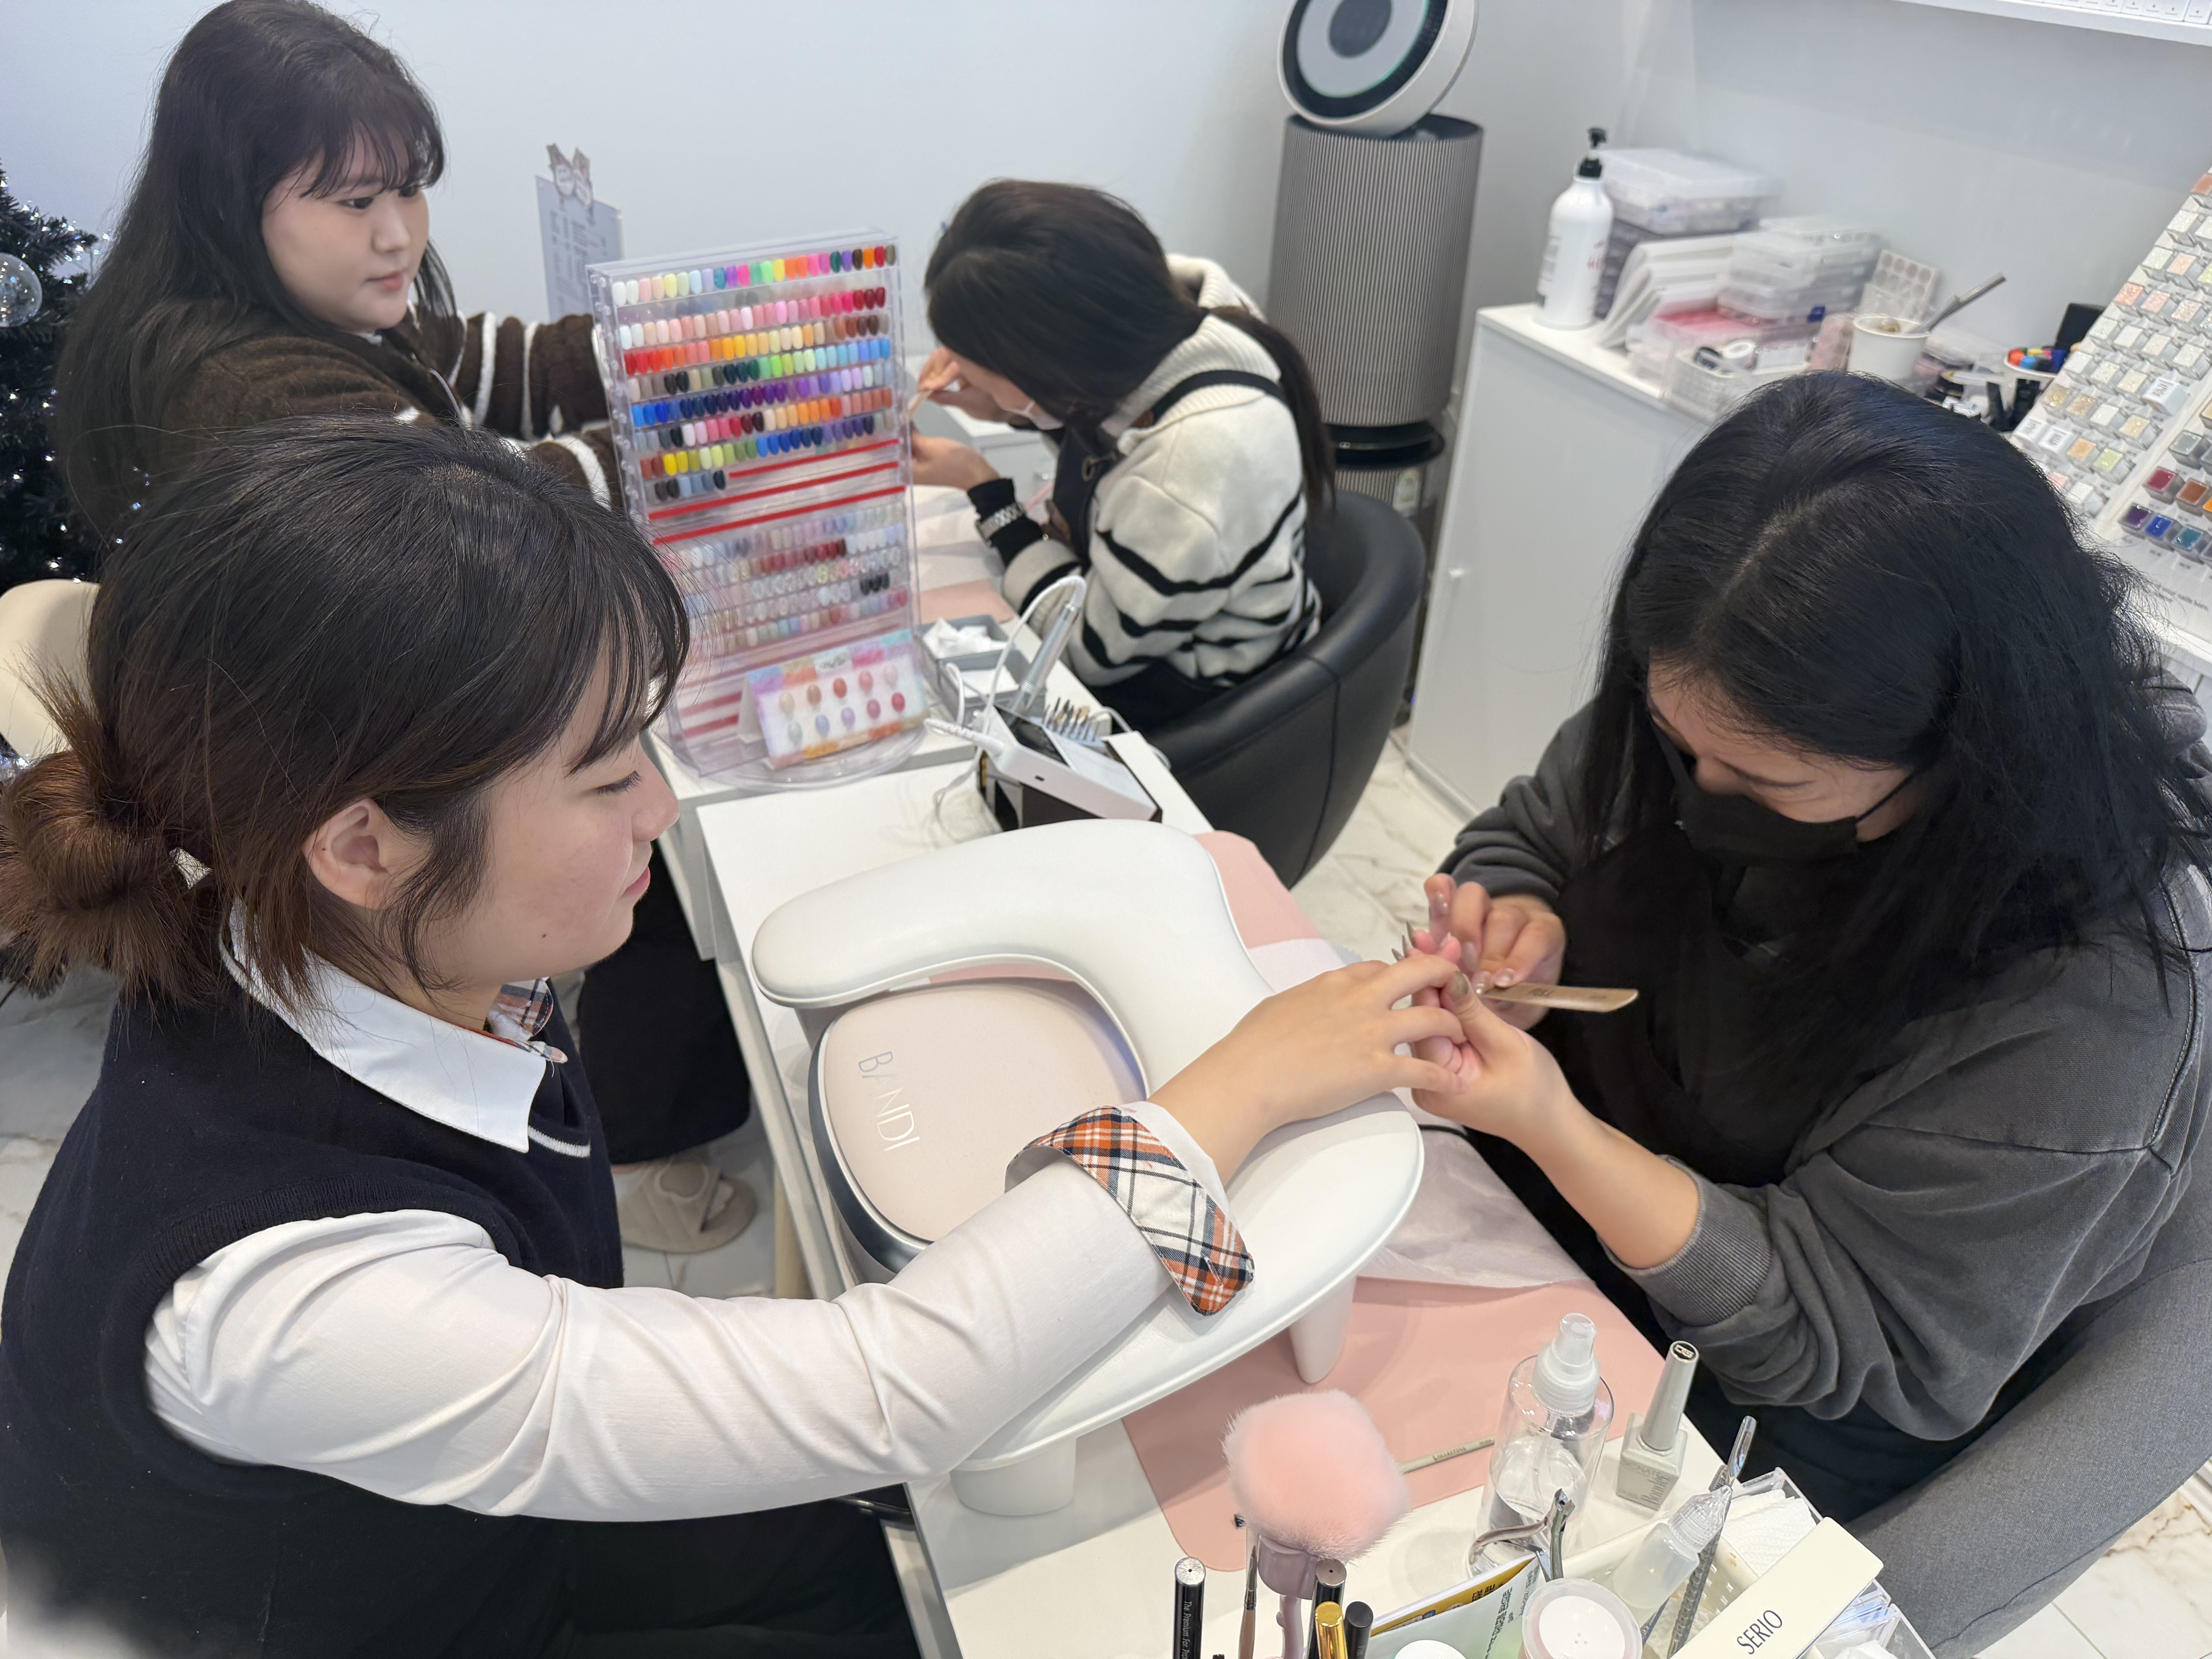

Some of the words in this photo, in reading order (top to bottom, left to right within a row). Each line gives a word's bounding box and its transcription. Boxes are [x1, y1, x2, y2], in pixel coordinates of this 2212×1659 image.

[1183, 1601, 1192, 1611] The
[1182, 1613, 1191, 1637] Premium
[1737, 1610, 1783, 1655] SERIO
[1182, 1638, 1190, 1648] For
